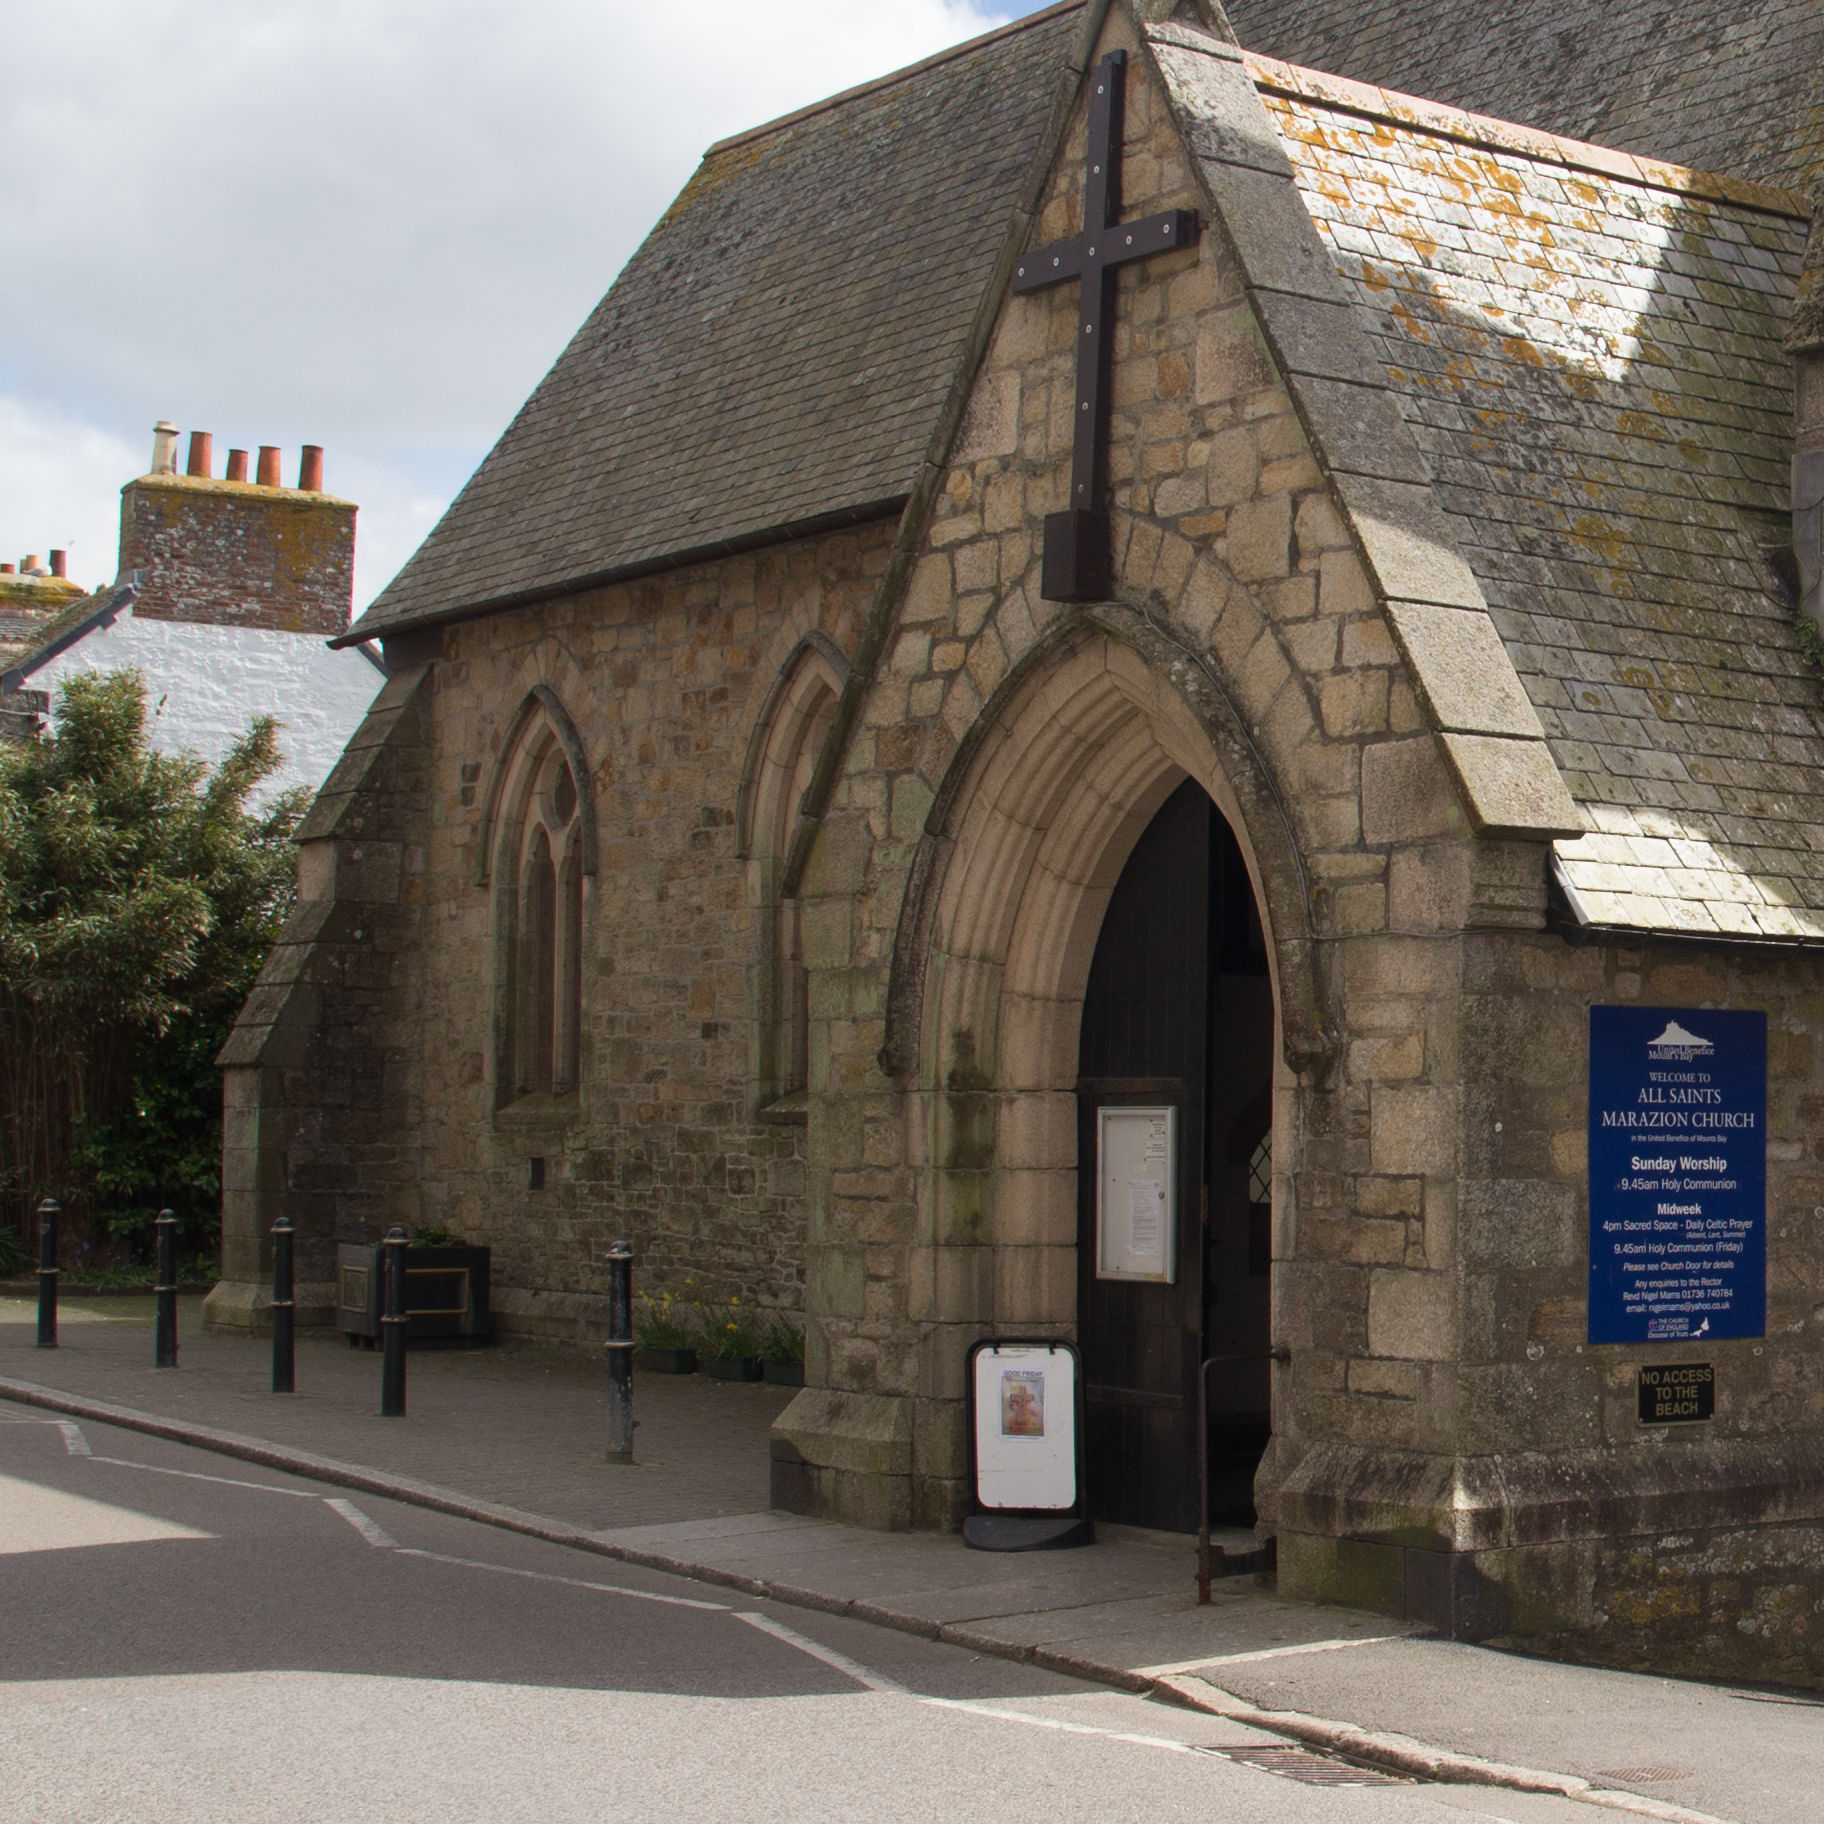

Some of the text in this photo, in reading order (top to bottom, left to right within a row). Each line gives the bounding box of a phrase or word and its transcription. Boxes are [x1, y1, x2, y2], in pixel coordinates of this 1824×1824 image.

[1649, 1072, 1711, 1084] WELCOME TO
[1637, 1087, 1721, 1104] ALL SAINTS
[1602, 1110, 1755, 1128] MARAZION CHURCH
[1638, 1134, 1647, 1142] the
[1666, 1134, 1689, 1142] Benefice
[1690, 1134, 1696, 1142] of
[1717, 1135, 1728, 1144] Bay
[1631, 1156, 1727, 1174] Sunday Worship
[1621, 1178, 1736, 1192] 9.45am Holy Communion
[1657, 1203, 1702, 1215] Midweek
[1602, 1220, 1622, 1233] 4pm
[1623, 1220, 1651, 1231] Sacred
[1653, 1220, 1679, 1232] Space
[1686, 1219, 1705, 1231] Daily
[1706, 1219, 1727, 1229] Celtic
[1729, 1218, 1753, 1231] Prayer
[1614, 1241, 1744, 1255] 9.45am Holy Communion (Friday)
[1623, 1260, 1734, 1271] Please see Church Door for details
[1635, 1277, 1722, 1290] Any enquiries to the Rector
[1641, 1368, 1712, 1385] NO ACCESS
[1655, 1385, 1698, 1400] TO THE
[1656, 1401, 1698, 1416] BEACH
